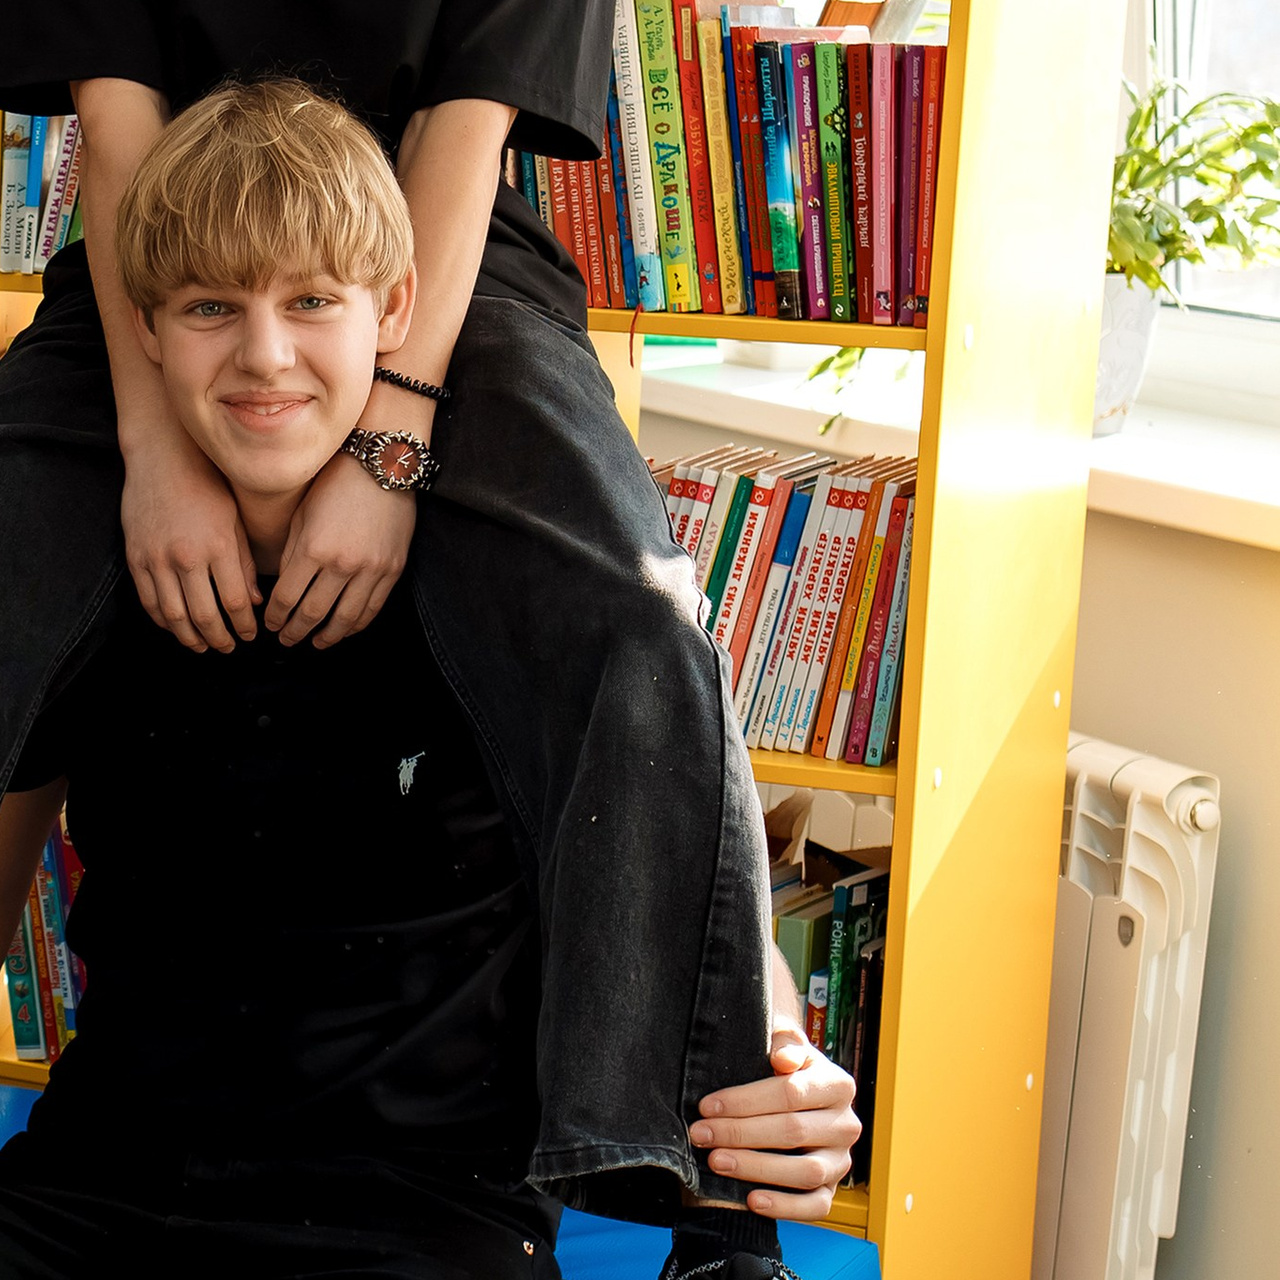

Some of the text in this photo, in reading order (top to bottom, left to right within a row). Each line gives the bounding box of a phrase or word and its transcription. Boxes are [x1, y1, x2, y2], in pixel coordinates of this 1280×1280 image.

[618, 24, 646, 238] СВИФТ ПУТЕШЕСТВИЯ ГУЛЛИВЕРА
[690, 114, 704, 168] АЗБУКА
[759, 57, 776, 122] Шарлотты
[648, 67, 683, 242] ВСЁ ДРАКОШЕ
[854, 135, 870, 248] Говорящий карман
[1, 203, 14, 255] Заходер
[826, 161, 845, 296] ЭВКАЛИПТОВЫЙ ПРИШЕЛЕЦ
[719, 511, 759, 619] БЛИЗ ДИКАНЬКИ
[785, 532, 829, 661] МЯГКИЙ ХАРАКТЕР
[799, 536, 842, 665] МЯГКИЙ ХАРАКТЕР
[814, 536, 857, 666] МЯГКИЙ ХАРАКТЕР
[867, 542, 882, 573] Стихи
[758, 588, 779, 647] ДЕТСТВО ТЁМЫ
[844, 645, 859, 685] дружбе
